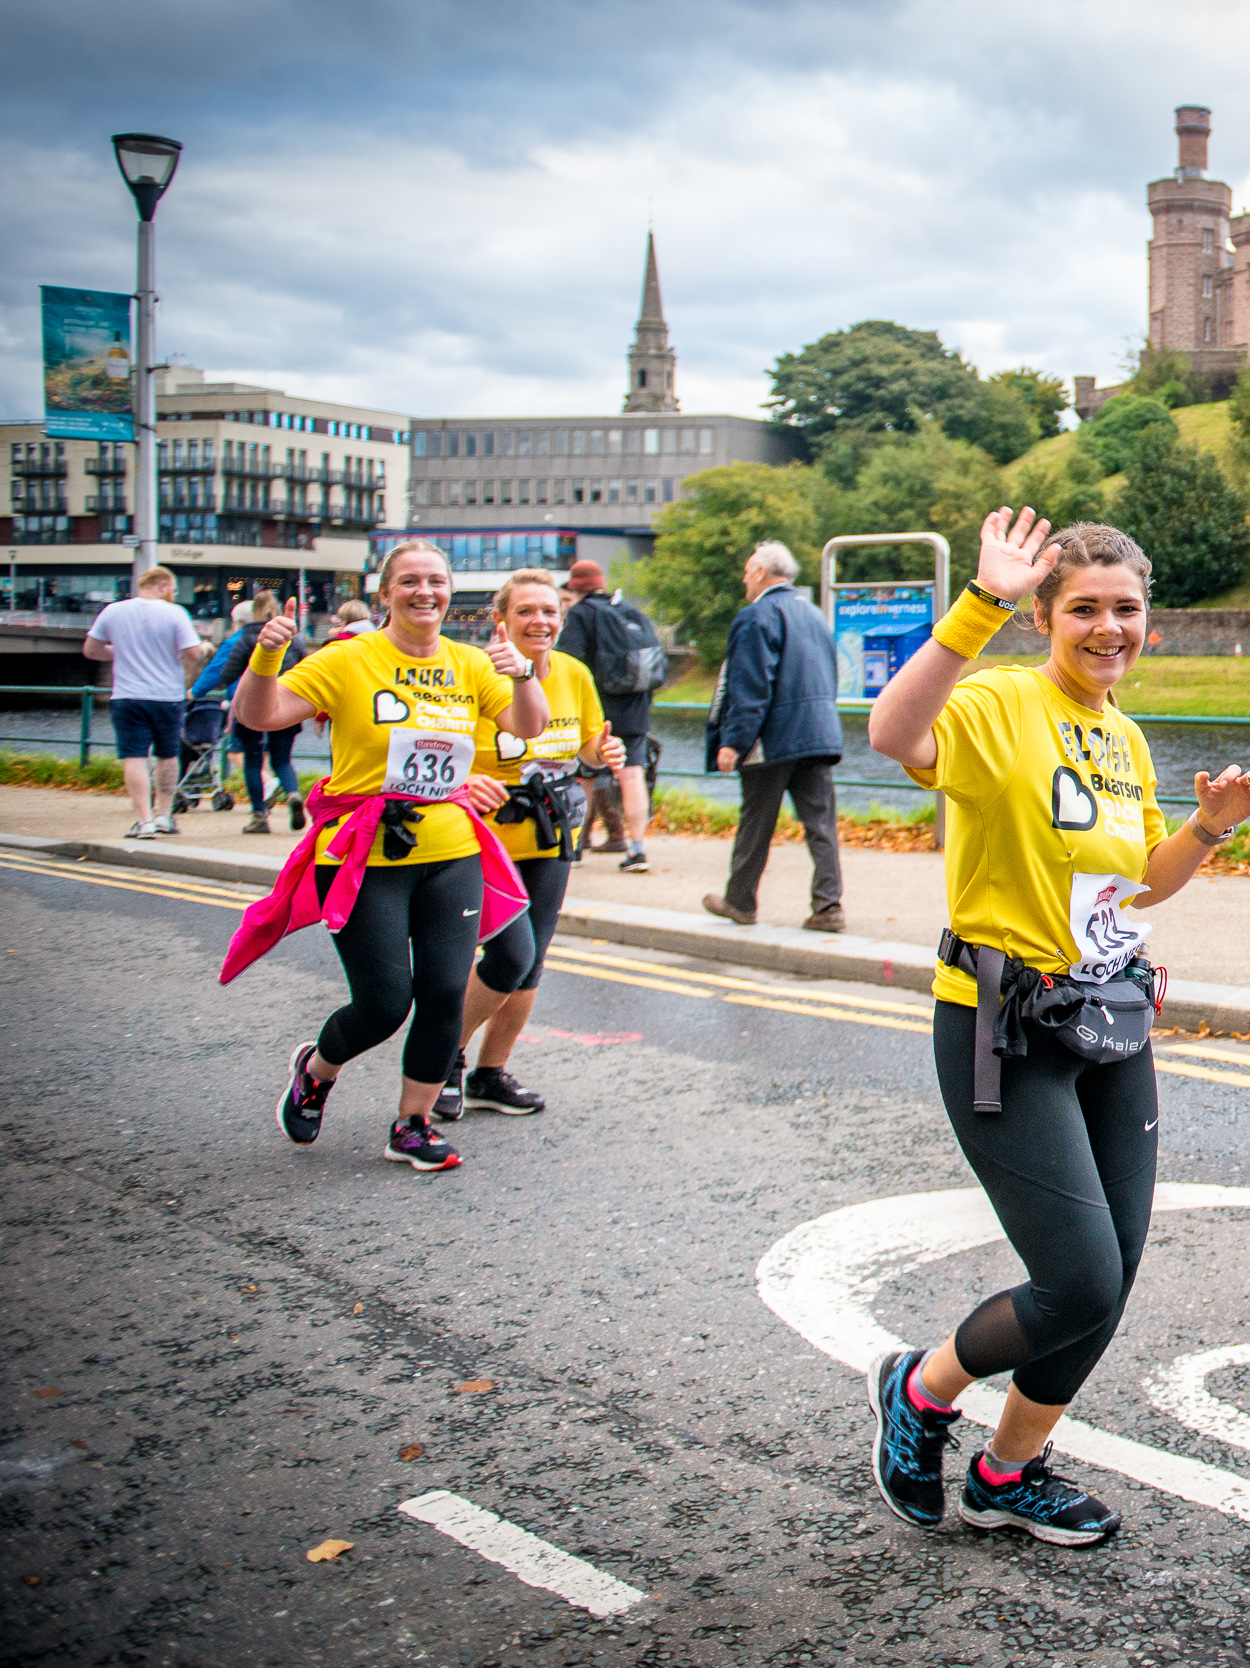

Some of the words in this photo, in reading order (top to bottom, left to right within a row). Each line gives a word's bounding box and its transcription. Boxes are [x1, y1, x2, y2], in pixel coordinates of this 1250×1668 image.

[395, 667, 456, 688] LAURA
[1058, 721, 1131, 773] ELOISE
[402, 753, 455, 784] 636
[389, 783, 426, 795] LOCH
[1080, 955, 1121, 979] LOCH
